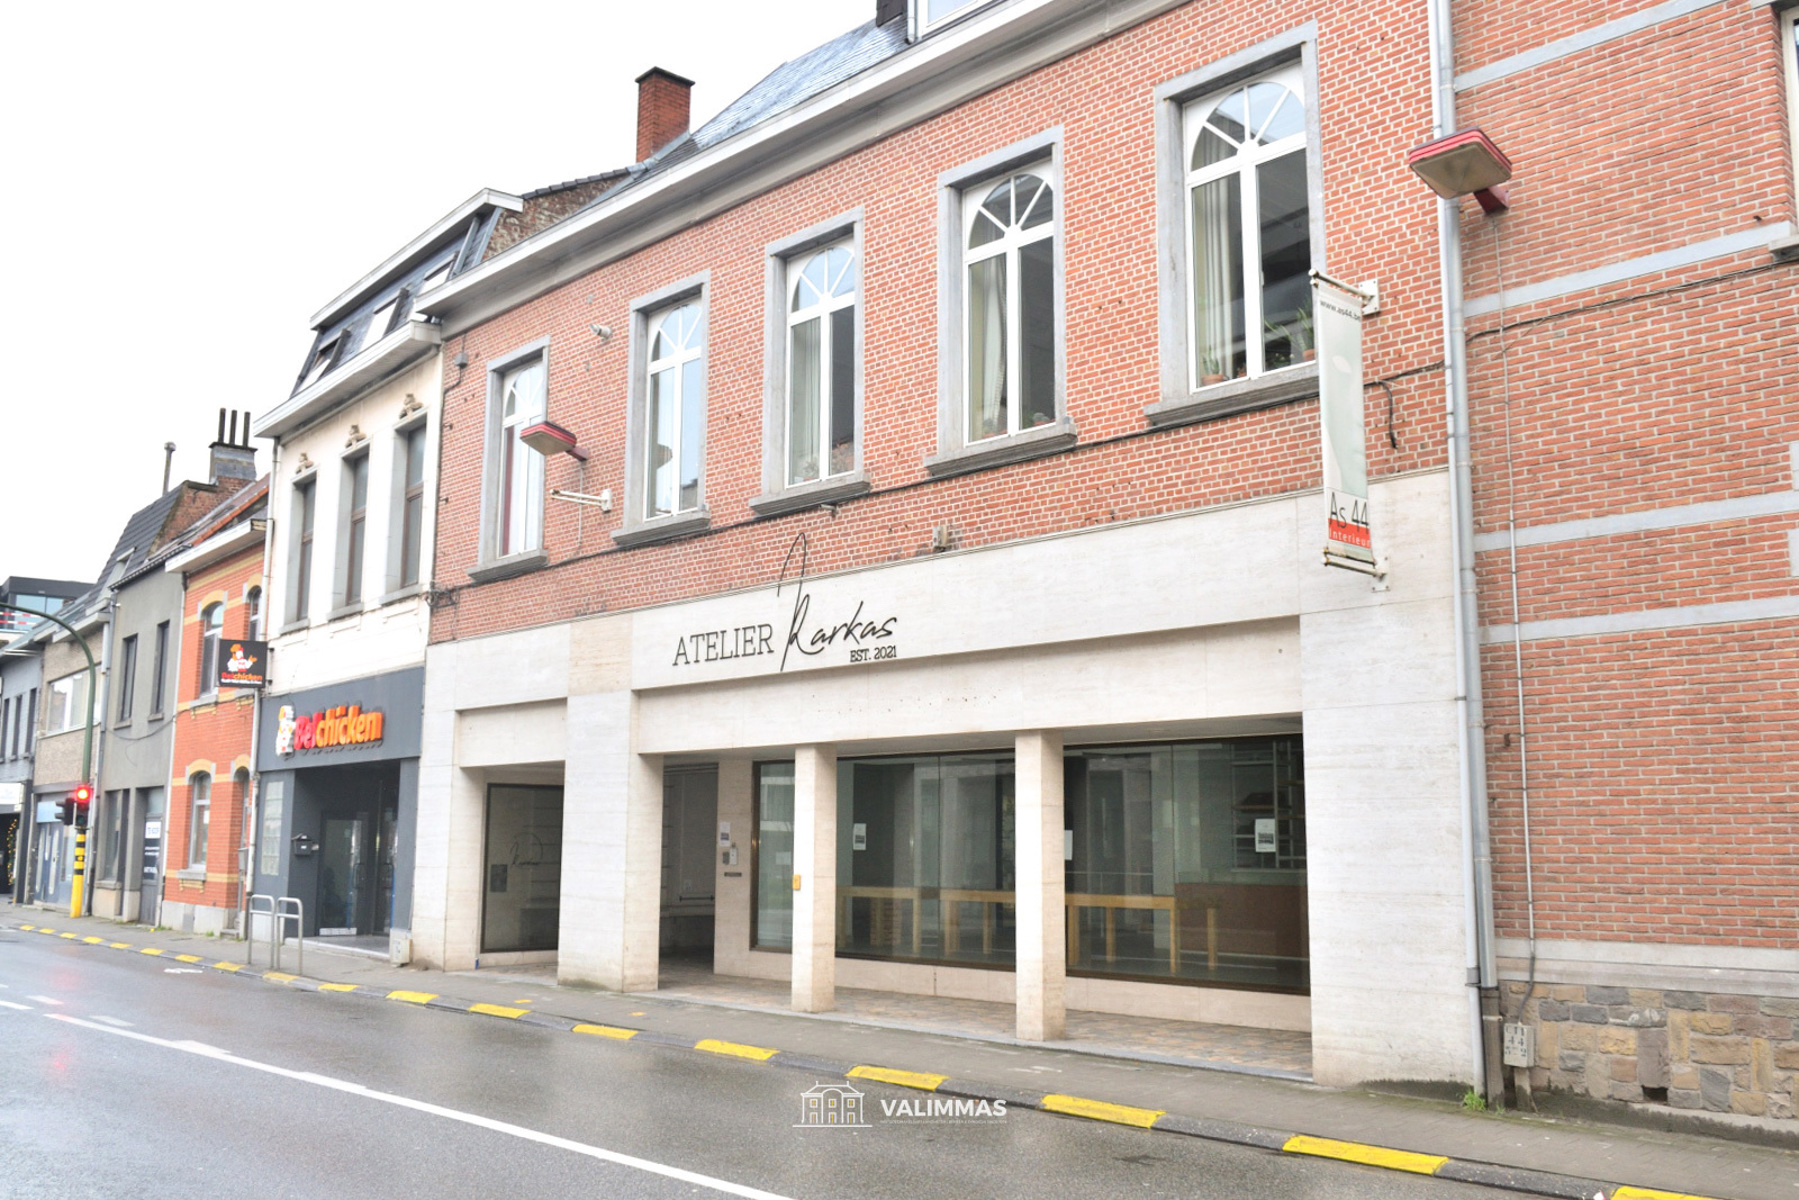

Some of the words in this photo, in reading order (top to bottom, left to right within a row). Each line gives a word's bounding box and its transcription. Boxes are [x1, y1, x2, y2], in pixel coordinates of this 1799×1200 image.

[1351, 500, 1369, 535] 44
[673, 624, 774, 666] ATELIER
[777, 532, 897, 672] Karkas
[850, 649, 871, 663] EST.
[874, 645, 897, 660] 2021
[294, 705, 383, 750] Belchicken
